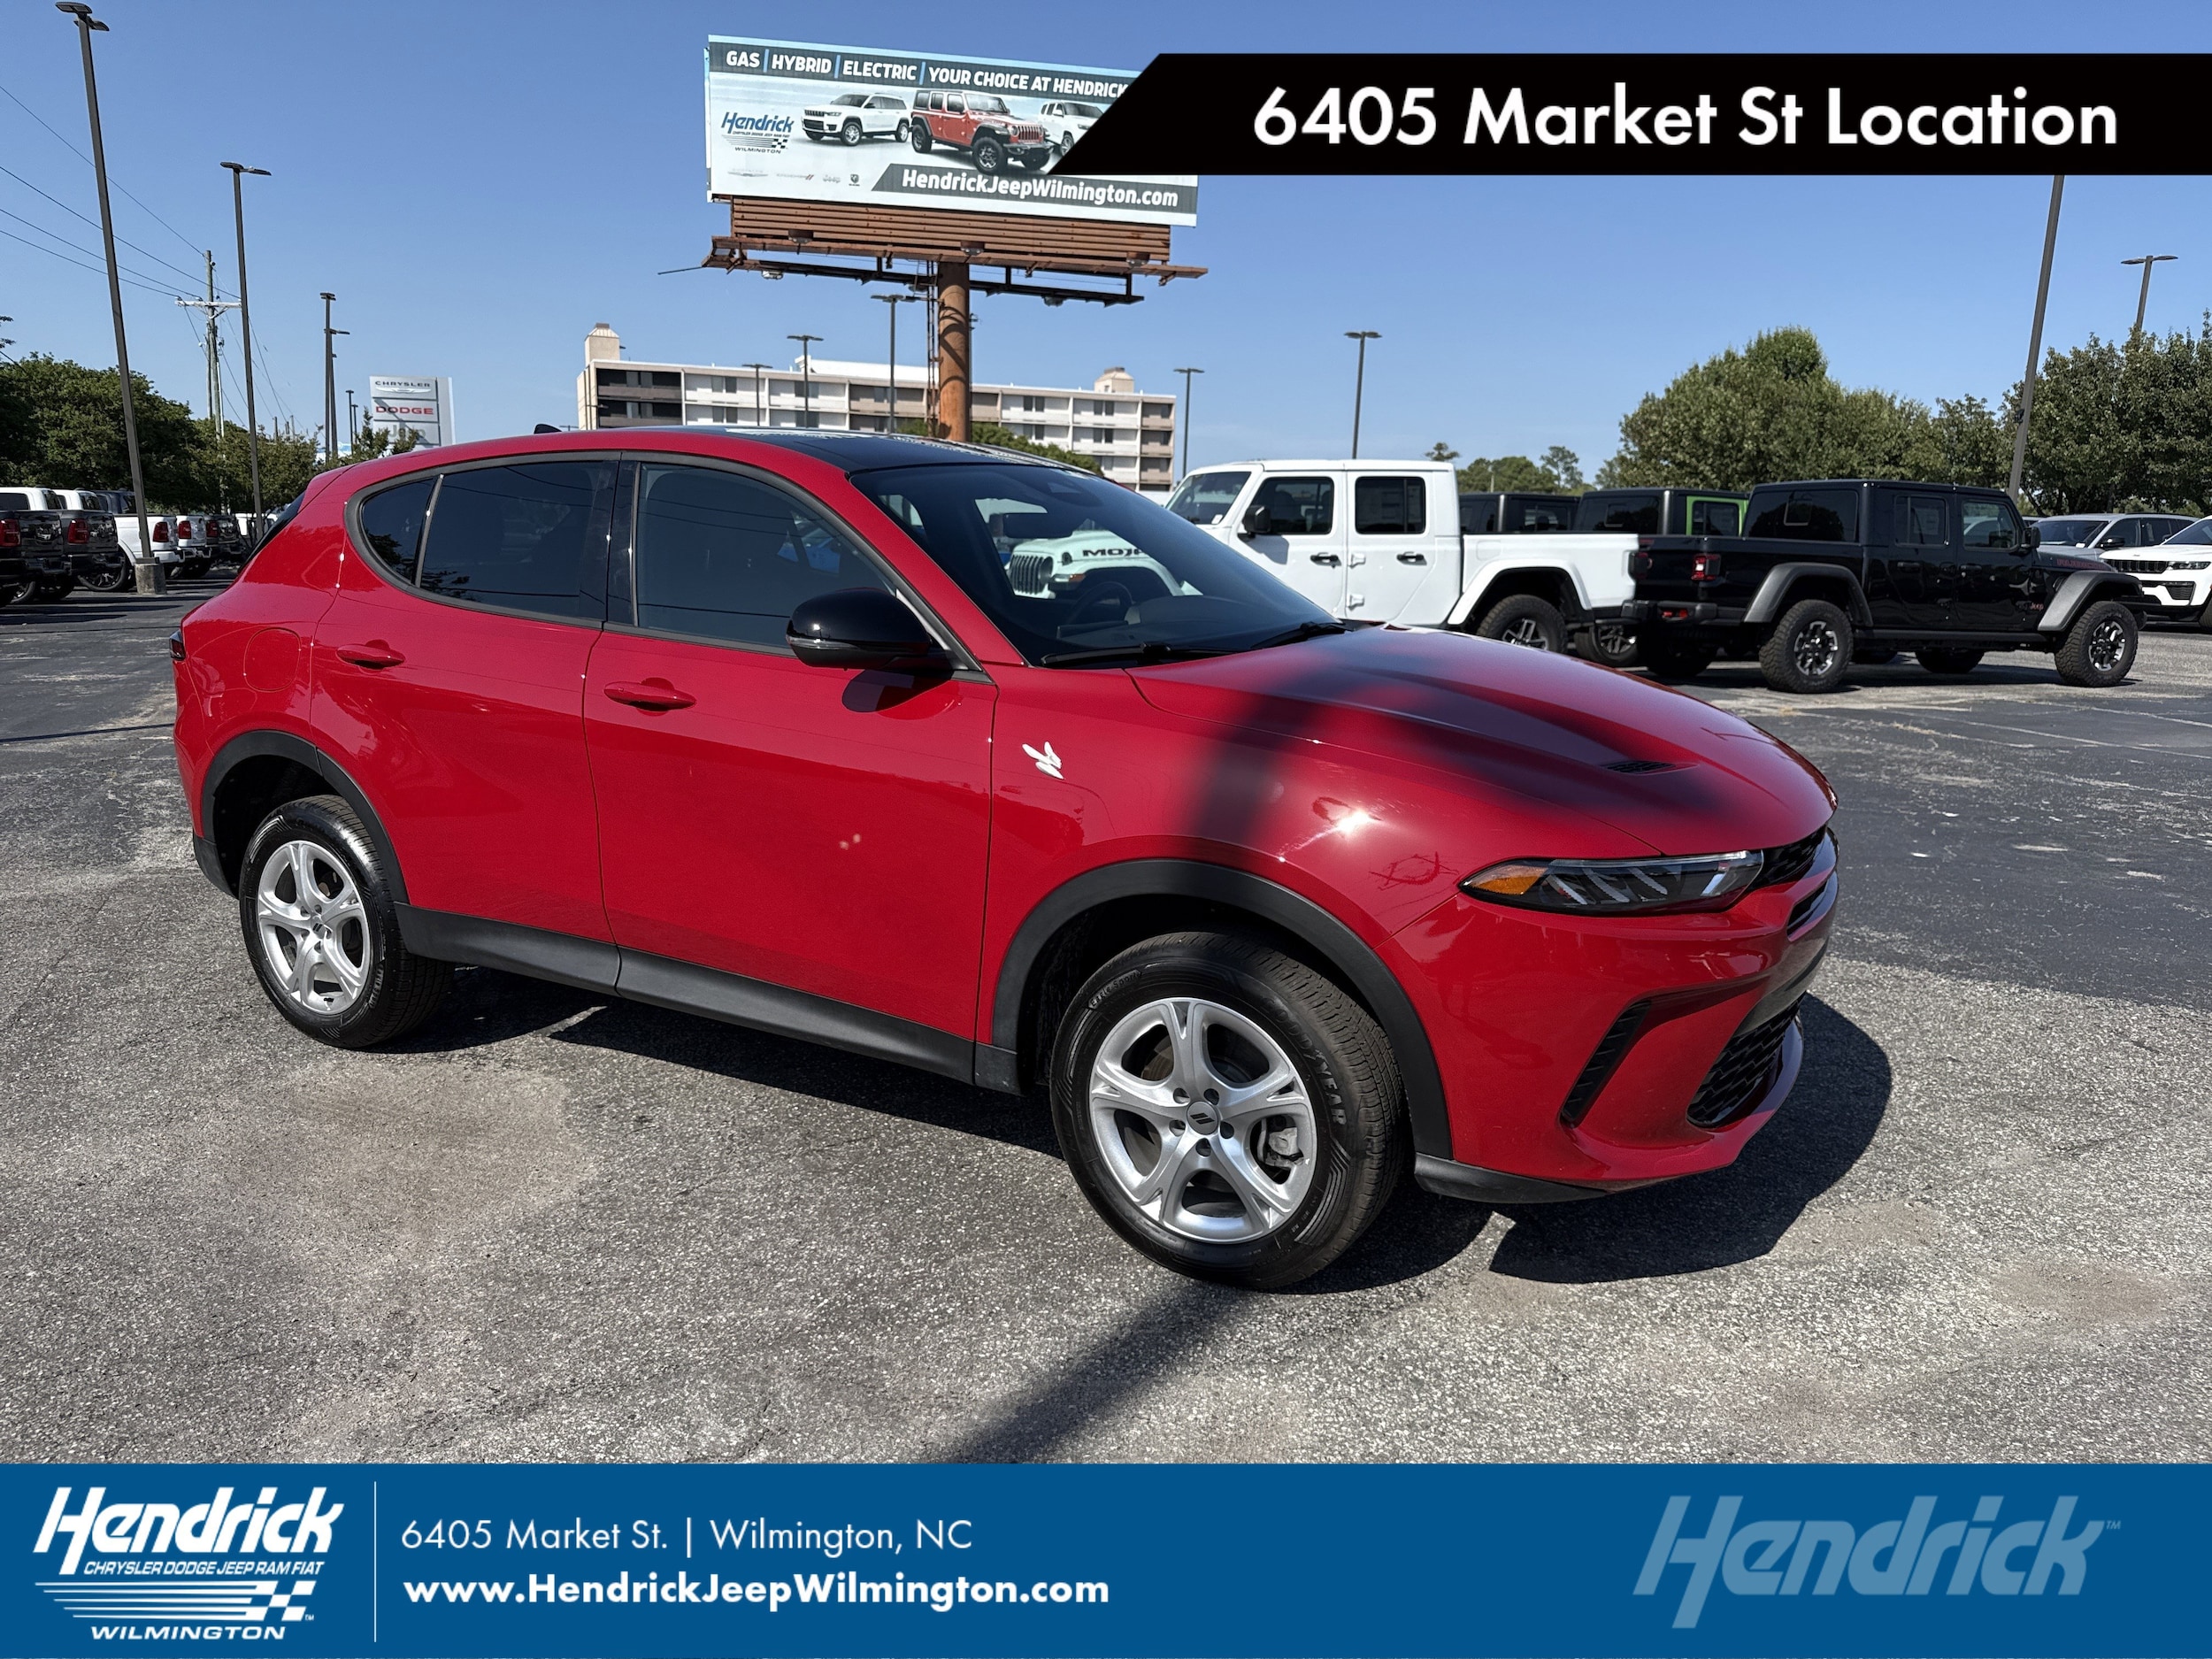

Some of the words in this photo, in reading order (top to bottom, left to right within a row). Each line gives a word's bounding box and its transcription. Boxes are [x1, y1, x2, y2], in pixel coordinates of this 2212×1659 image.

[726, 50, 760, 68] GAS
[771, 54, 833, 74] HYBRID
[842, 59, 918, 81] ELECTRIC
[928, 66, 971, 85] YOUR
[973, 70, 1029, 90] CHOICE
[1030, 76, 1052, 92] AT
[721, 111, 795, 134] Hendrick
[902, 168, 1179, 208] HendrickJeepWilmington.com
[375, 406, 434, 415] DODGE
